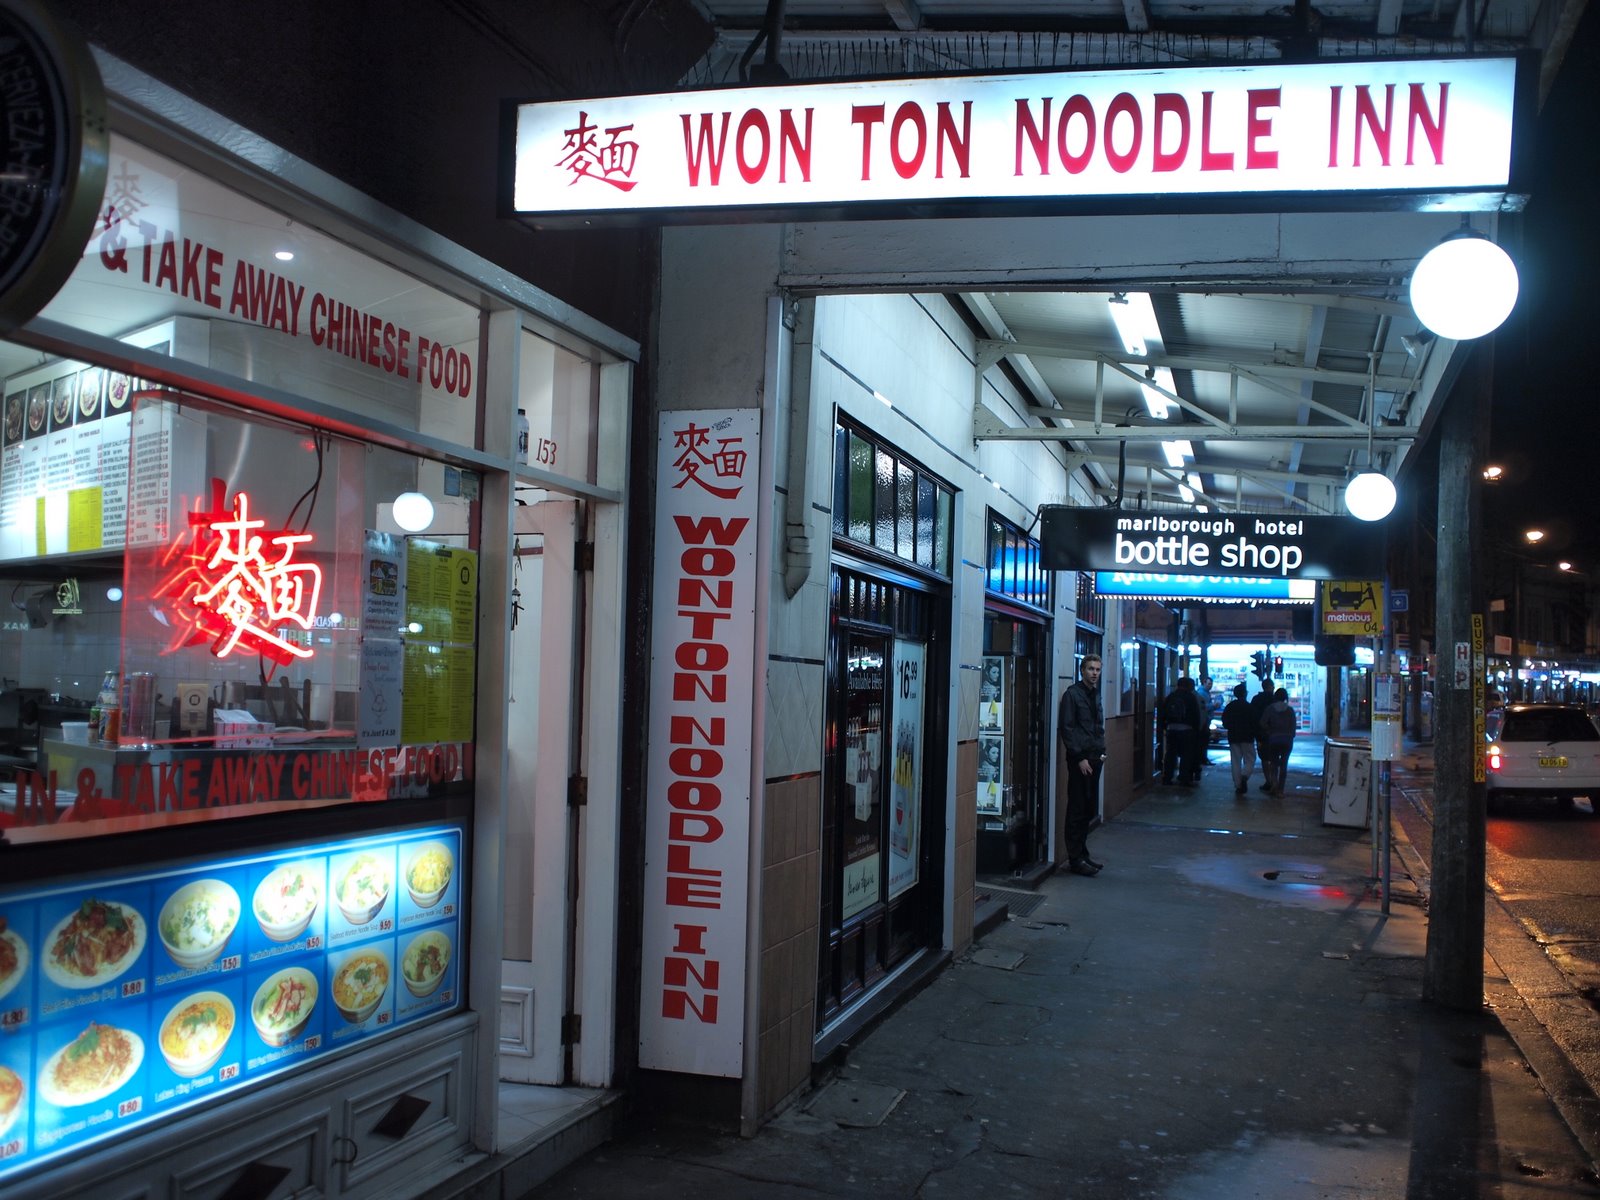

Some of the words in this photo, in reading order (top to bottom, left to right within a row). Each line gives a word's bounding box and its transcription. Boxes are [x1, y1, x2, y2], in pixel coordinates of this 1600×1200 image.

[679, 107, 815, 187] WON
[851, 100, 974, 181] TON
[1013, 84, 1282, 177] NOODLE
[1328, 81, 1452, 168] INN
[99, 205, 128, 274] &
[139, 219, 224, 310] TAKE
[229, 259, 305, 337] AWAY
[310, 292, 411, 379] CHINESE
[416, 336, 472, 399] FOOD
[535, 437, 558, 466] 153
[1117, 516, 1235, 536] marlborough
[1255, 519, 1304, 536] hotel
[1115, 532, 1210, 567] bottle
[1220, 536, 1303, 576] shop
[1327, 613, 1371, 622] metrobus
[1363, 622, 1378, 632] 04
[1474, 677, 1486, 720] KEEP
[15, 768, 58, 827] IN
[73, 767, 103, 823] &
[117, 758, 201, 815] TAKE
[206, 752, 288, 807] AWAY
[291, 746, 397, 799] CHINESE
[401, 743, 459, 787] FOOD
[665, 716, 725, 910] NOODLE
[662, 923, 720, 1025] INN
